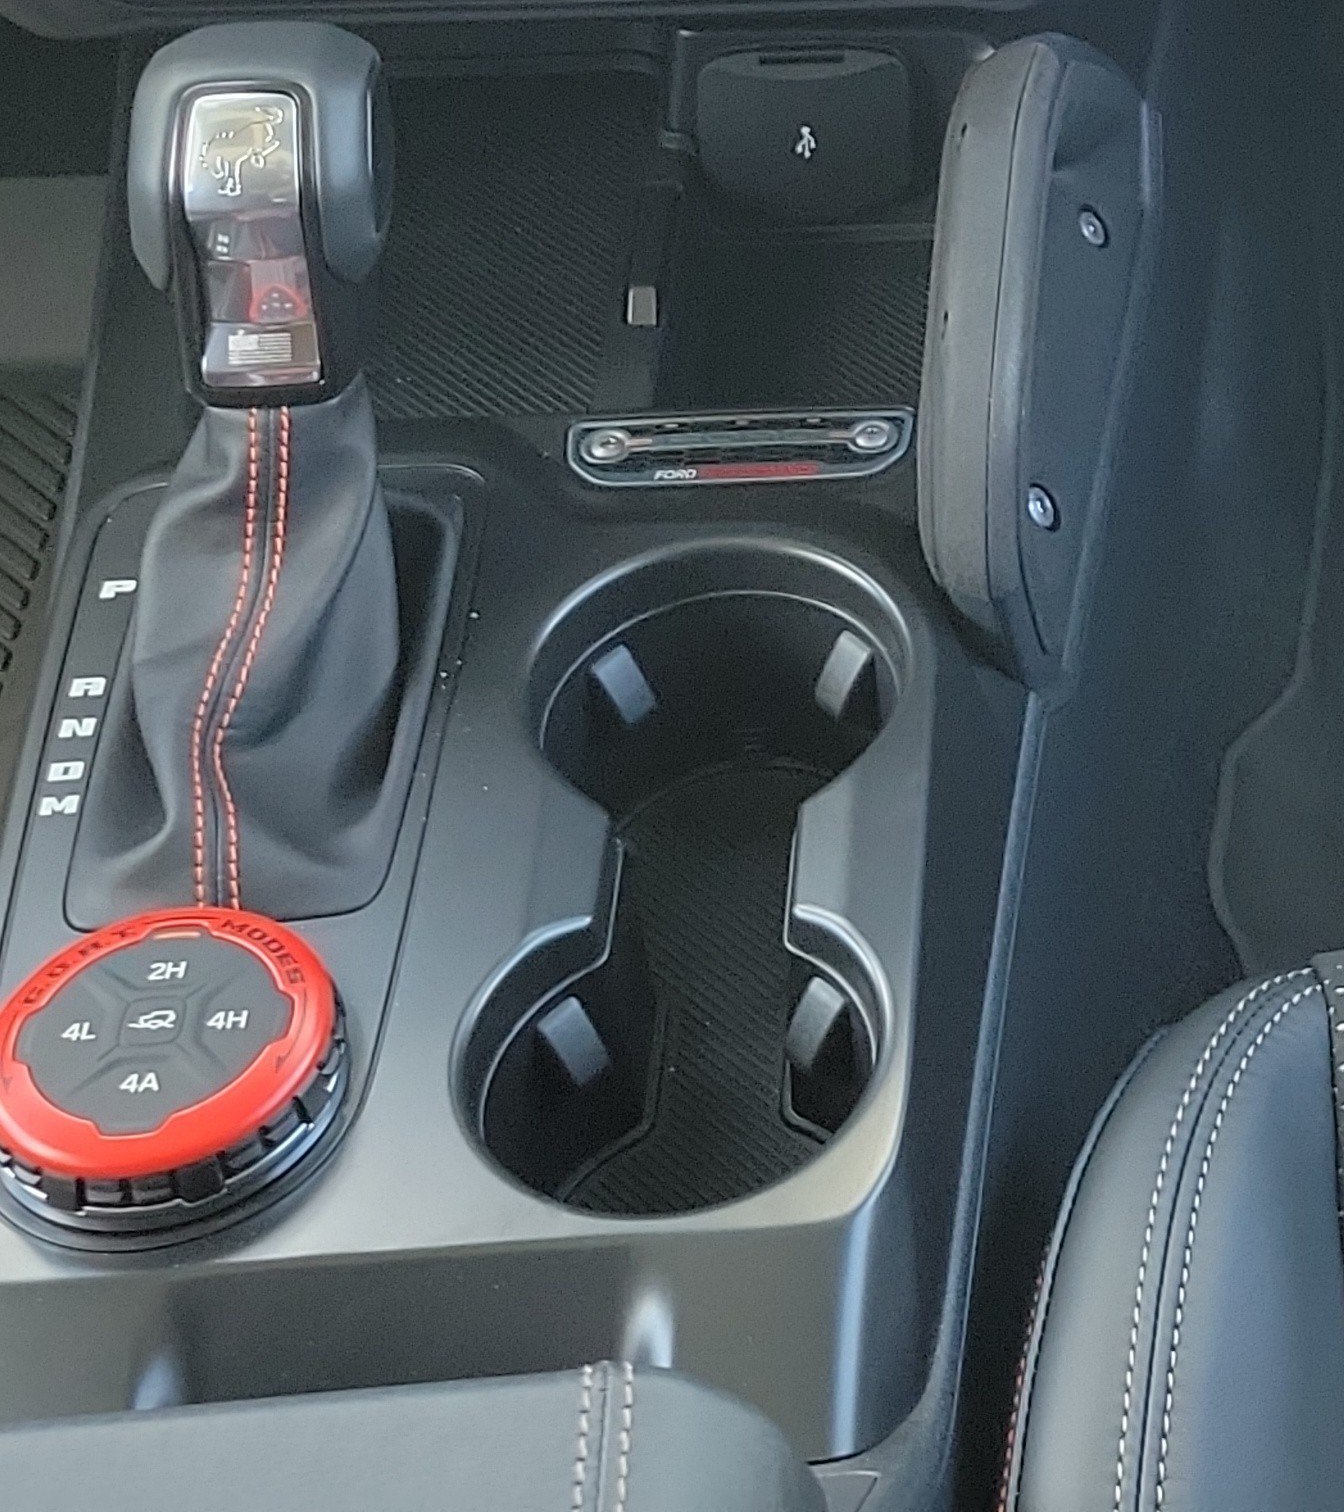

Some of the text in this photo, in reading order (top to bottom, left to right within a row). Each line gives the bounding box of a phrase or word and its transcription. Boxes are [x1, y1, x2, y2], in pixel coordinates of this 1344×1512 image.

[653, 468, 698, 481] FORD
[99, 579, 137, 599] P
[68, 676, 106, 697] R
[58, 717, 98, 738] N
[46, 760, 85, 782] D
[38, 794, 80, 816] M
[220, 918, 306, 984] MODES
[147, 960, 188, 981] 2H
[206, 1009, 249, 1030] 4H
[60, 1022, 97, 1041] 4L
[119, 1072, 160, 1093] 4A
